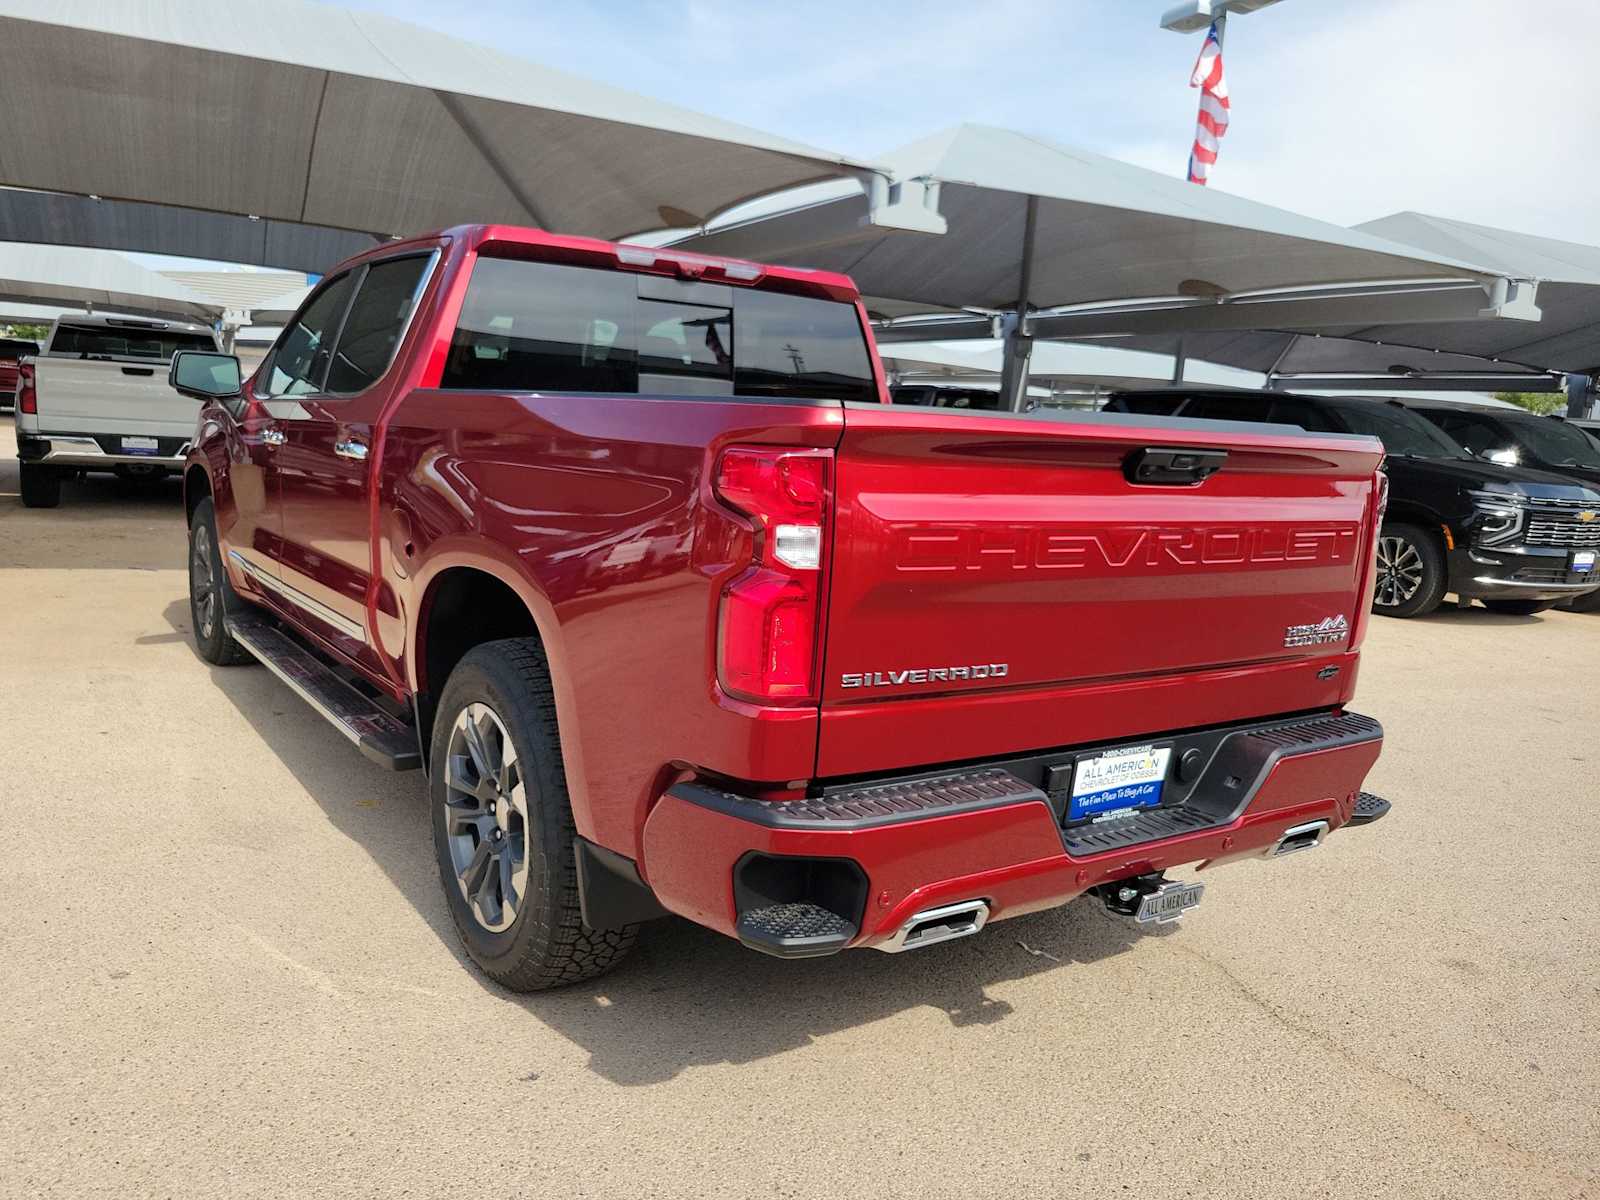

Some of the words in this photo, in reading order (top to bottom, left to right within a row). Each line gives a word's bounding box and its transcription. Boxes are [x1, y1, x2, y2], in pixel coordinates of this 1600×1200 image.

[897, 528, 1353, 570] CHEVROLET
[1283, 631, 1347, 648] COUNTRY
[841, 663, 1009, 688] SILVERADO
[1083, 767, 1103, 779] ALL
[1105, 758, 1160, 776] AMERICAN
[1078, 797, 1089, 807] The
[1090, 796, 1102, 806] Fun
[1102, 792, 1117, 803] Place
[1124, 788, 1136, 798] Buy
[1143, 784, 1155, 794] Car
[1145, 902, 1159, 915] ALL
[1161, 890, 1198, 913] AMERICAN
